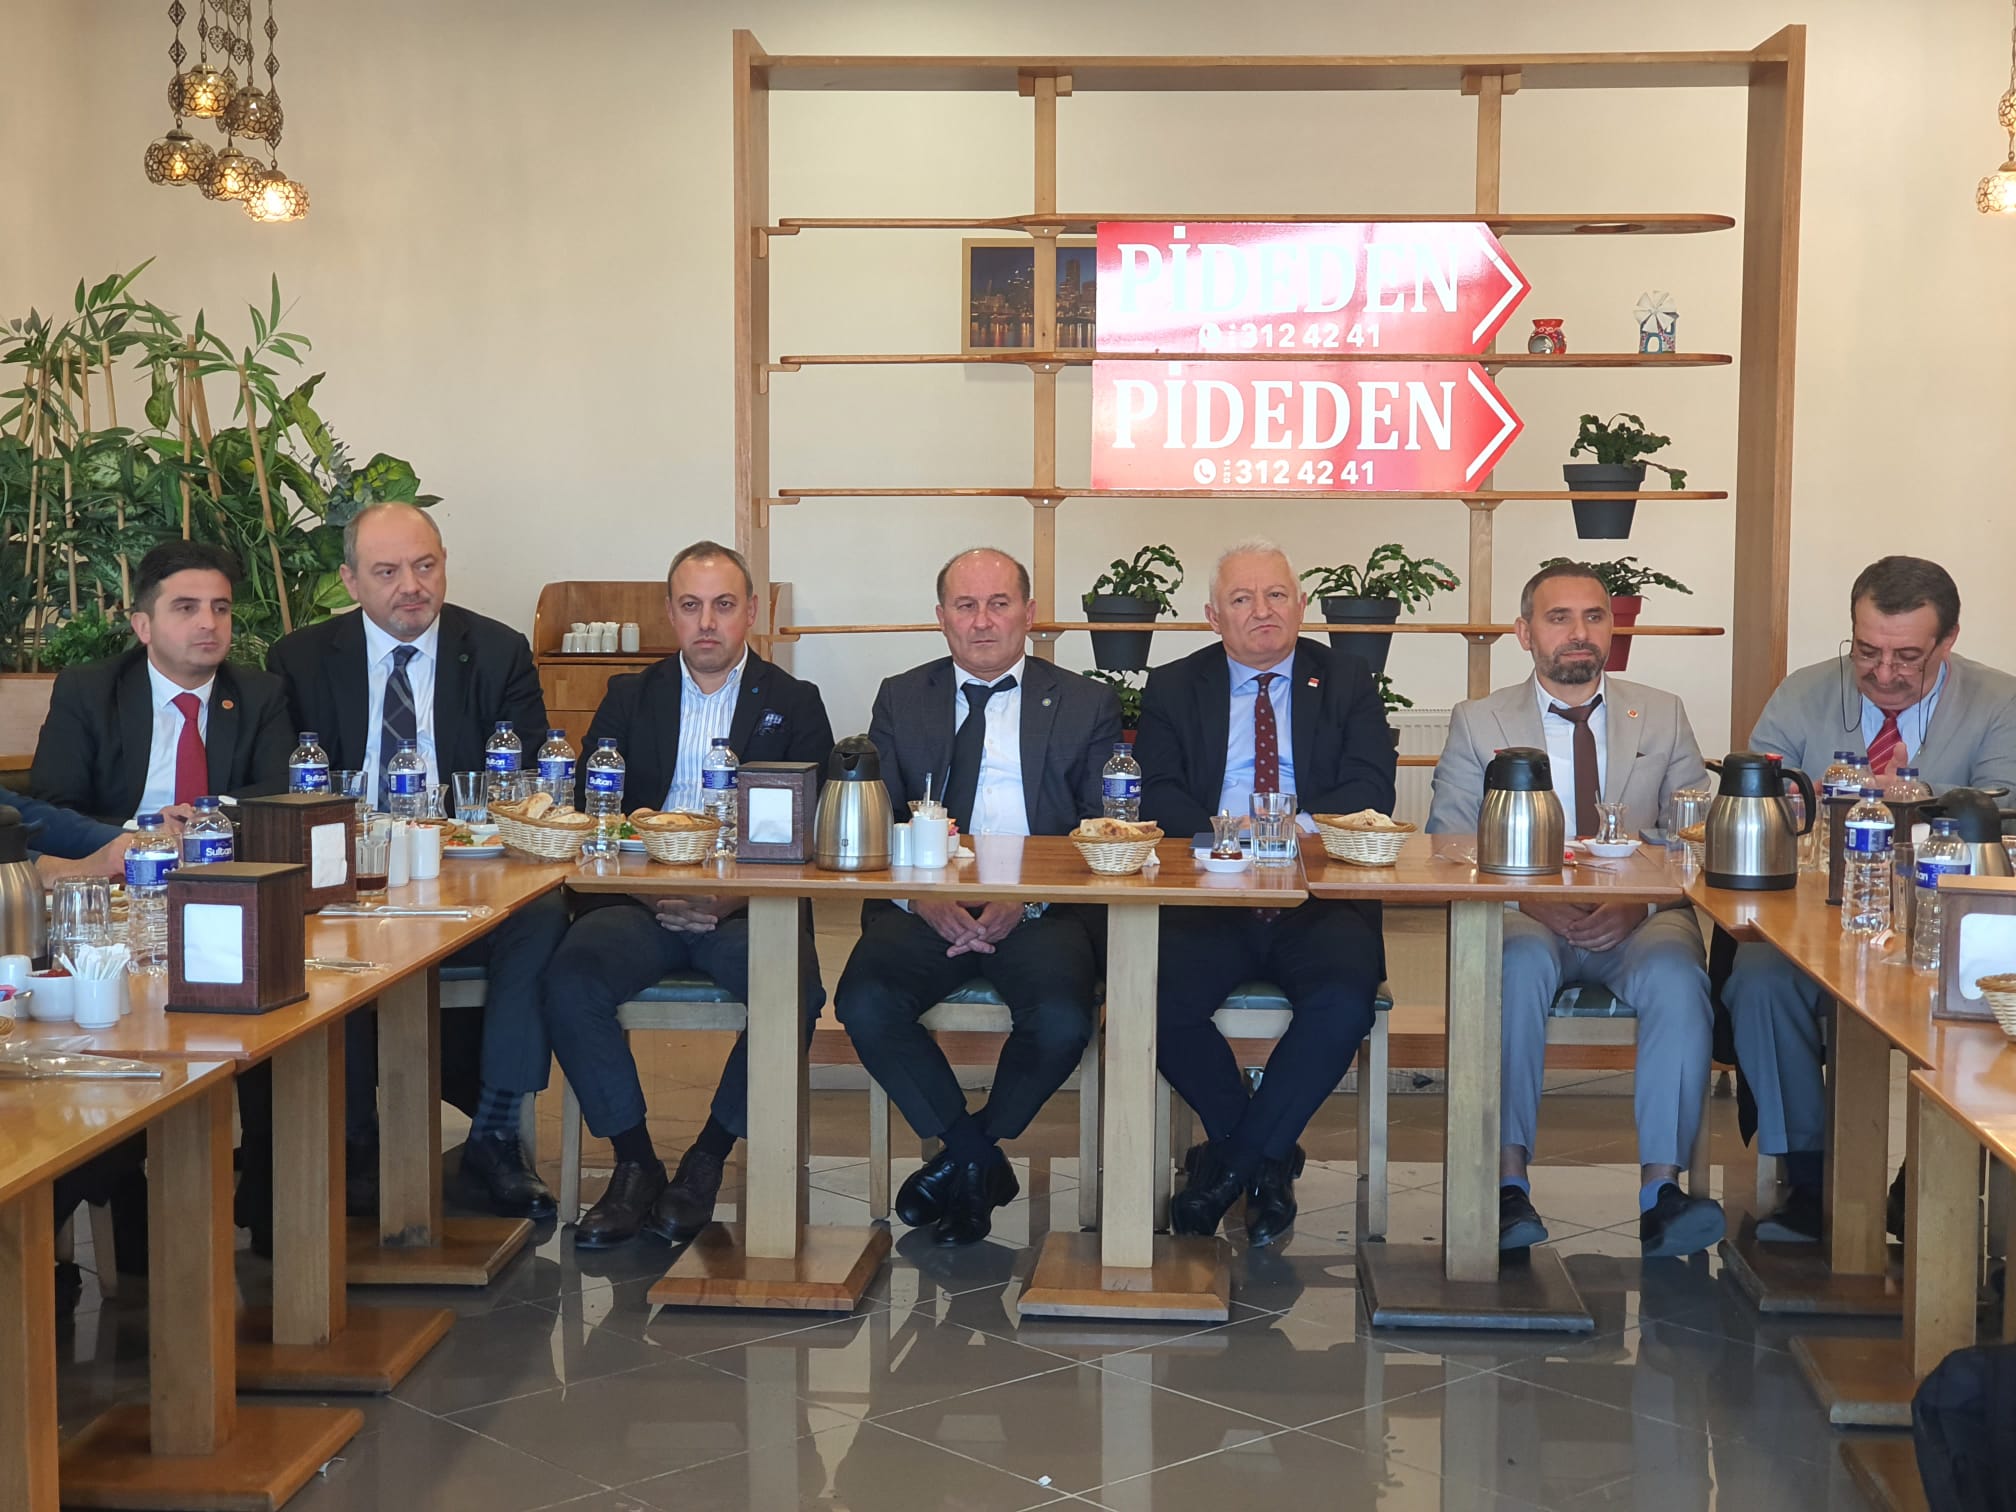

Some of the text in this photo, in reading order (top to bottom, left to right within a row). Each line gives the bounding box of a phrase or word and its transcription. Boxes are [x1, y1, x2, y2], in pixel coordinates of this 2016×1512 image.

[1117, 225, 1461, 314] PİDEDEN
[1240, 322, 1296, 348] 312
[1302, 323, 1339, 348] 42
[1346, 323, 1380, 348] 41
[1111, 361, 1456, 451] PİDEDEN
[1235, 459, 1290, 485] 312
[1297, 460, 1334, 485] 42
[1340, 460, 1375, 485] 41
